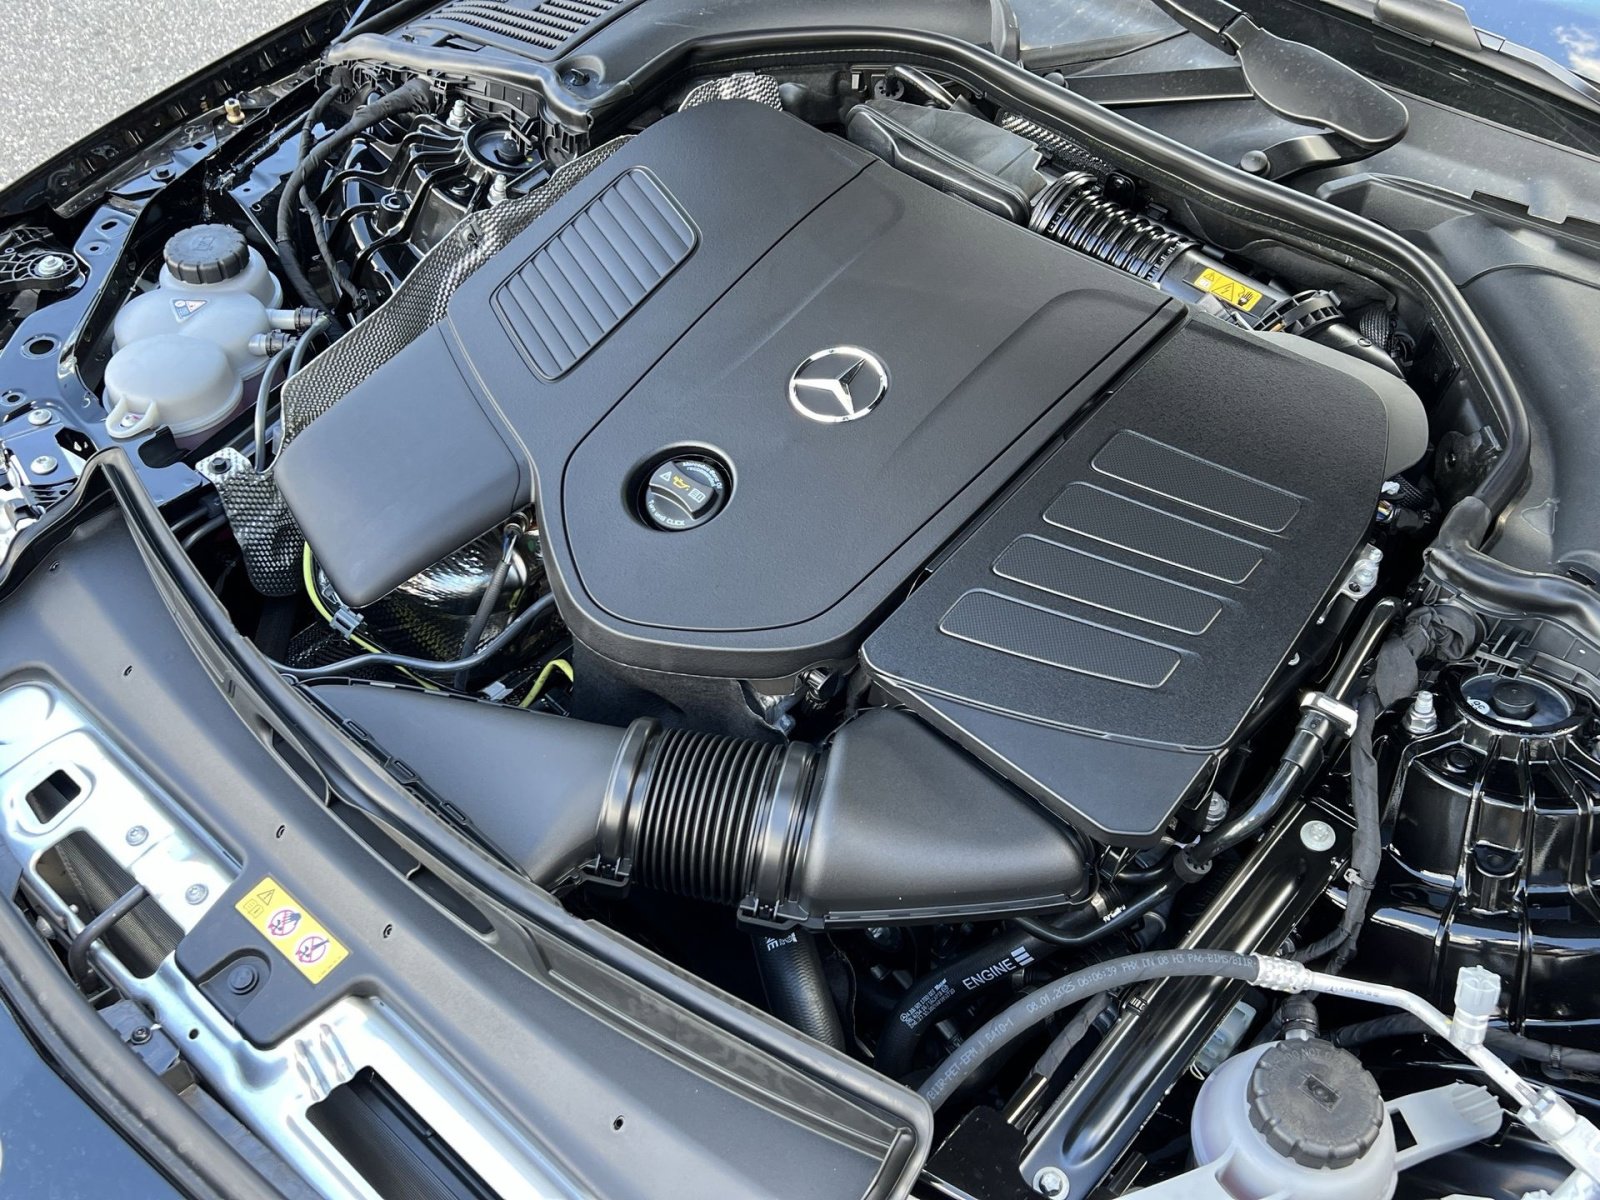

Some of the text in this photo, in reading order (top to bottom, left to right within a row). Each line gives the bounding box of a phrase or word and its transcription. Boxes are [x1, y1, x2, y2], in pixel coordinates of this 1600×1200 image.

[666, 518, 685, 526] CLICK
[962, 957, 1017, 991] ENGINE
[1026, 981, 1075, 1013] 08.01.2025
[1077, 966, 1117, 987] 06:06:39
[1157, 955, 1169, 966] 08
